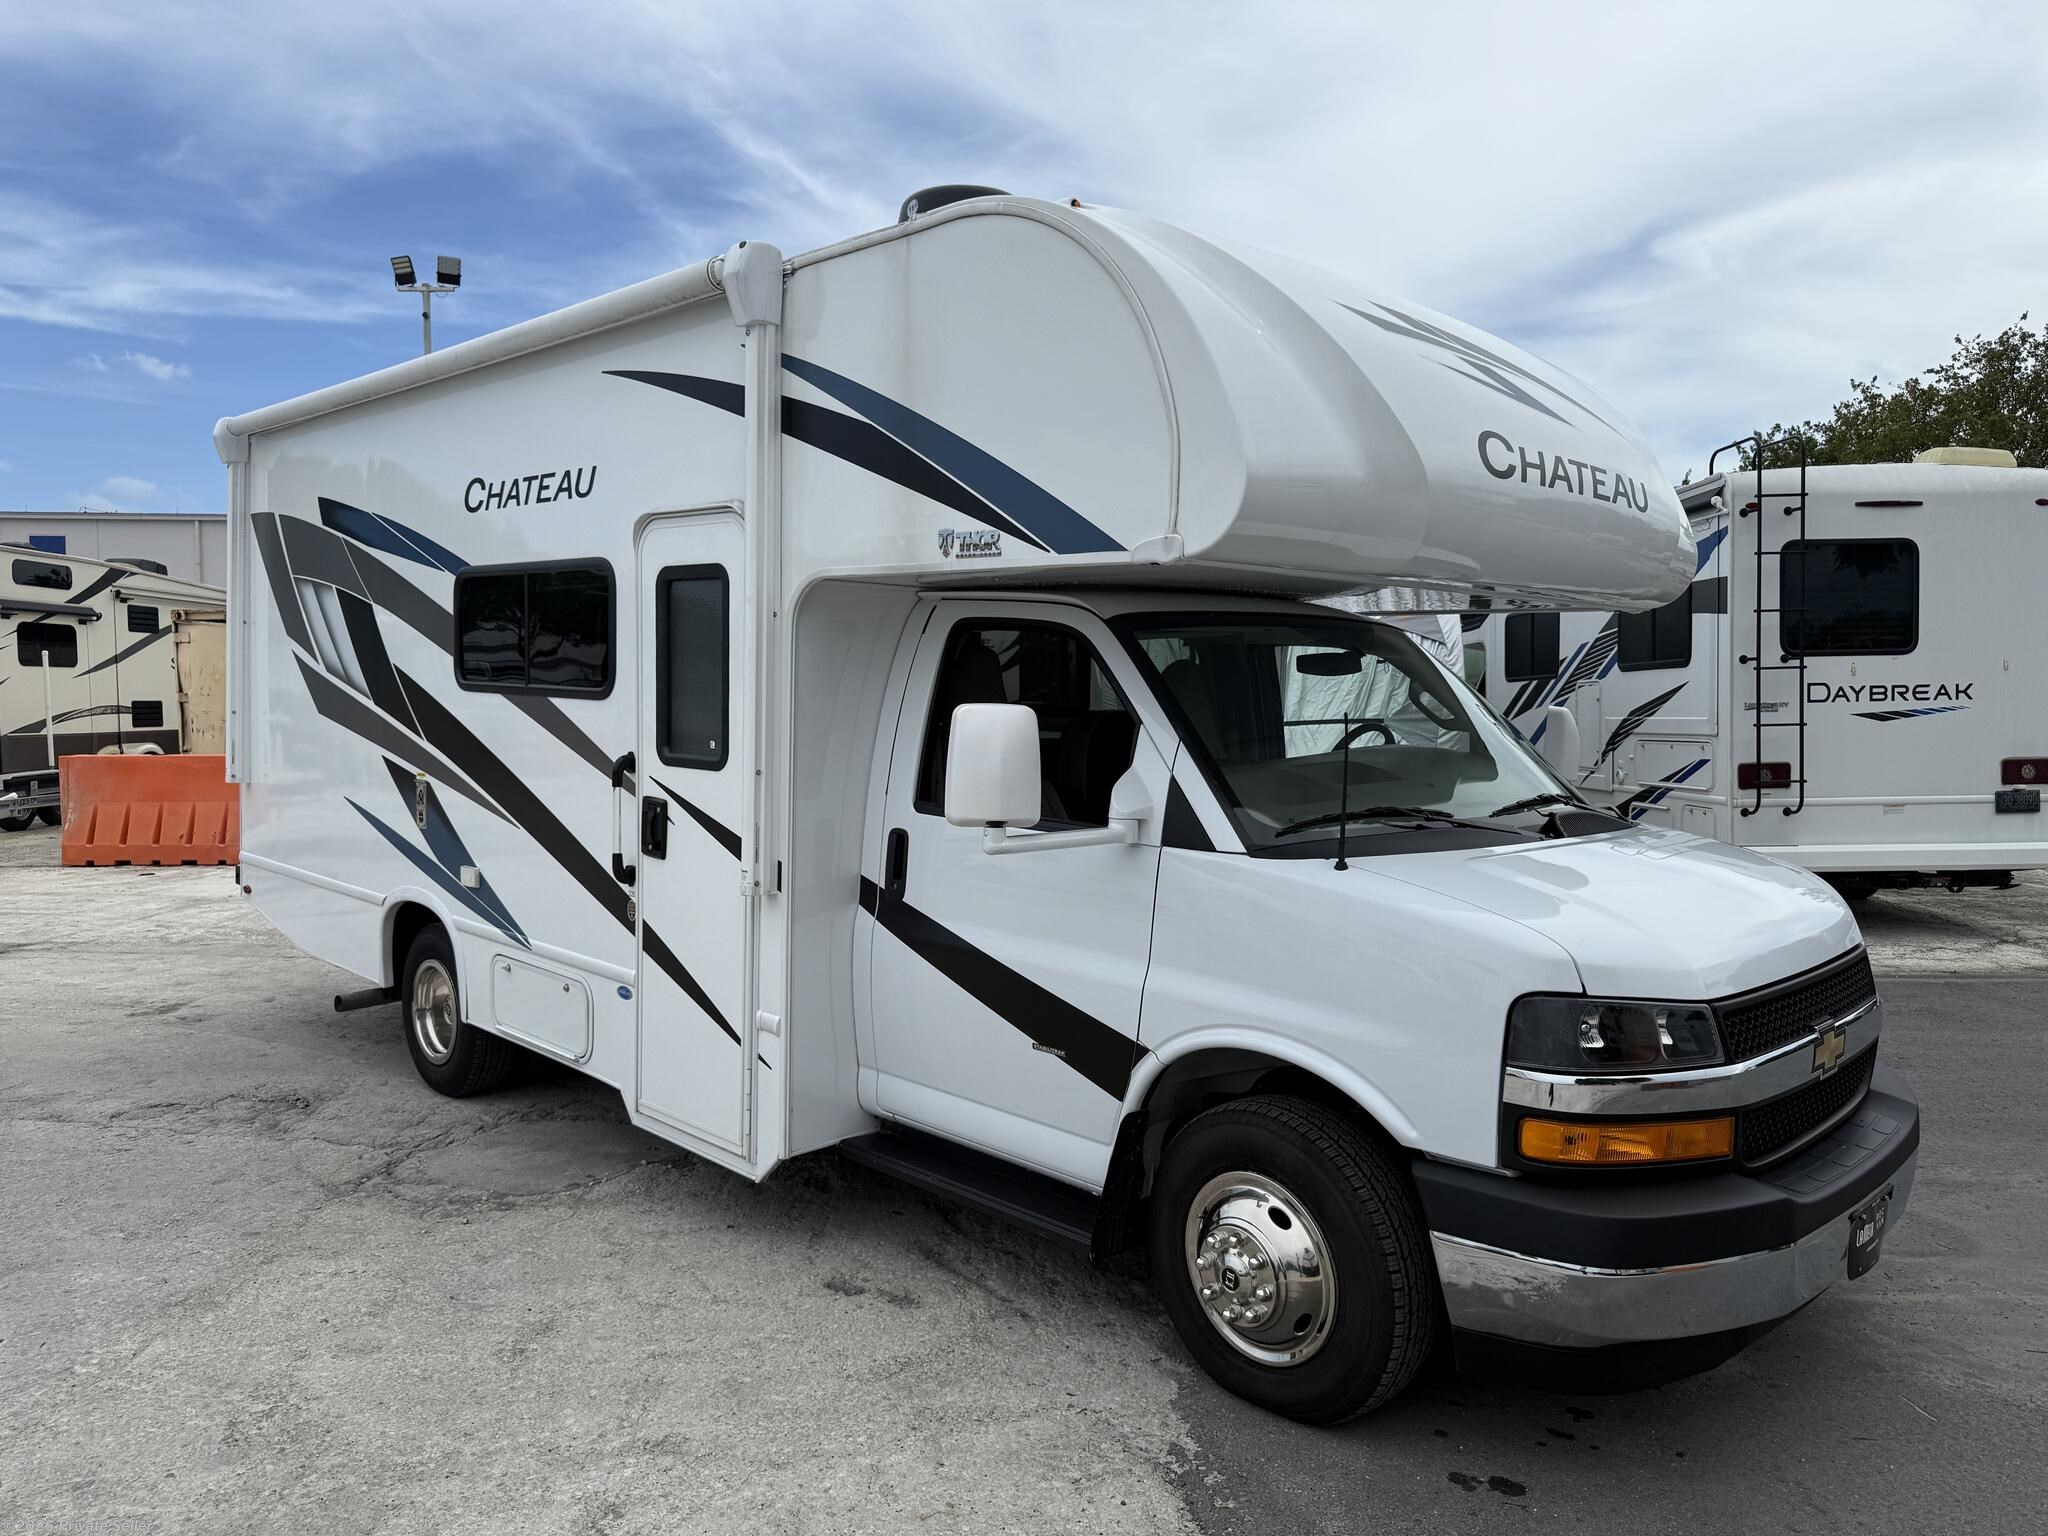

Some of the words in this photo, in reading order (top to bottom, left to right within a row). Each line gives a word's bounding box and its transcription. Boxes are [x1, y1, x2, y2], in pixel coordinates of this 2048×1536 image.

[1478, 430, 1649, 513] CHATEAU
[464, 465, 598, 513] CHATEAU
[956, 531, 1002, 551] THOR
[1807, 682, 1974, 703] DAYBREAK
